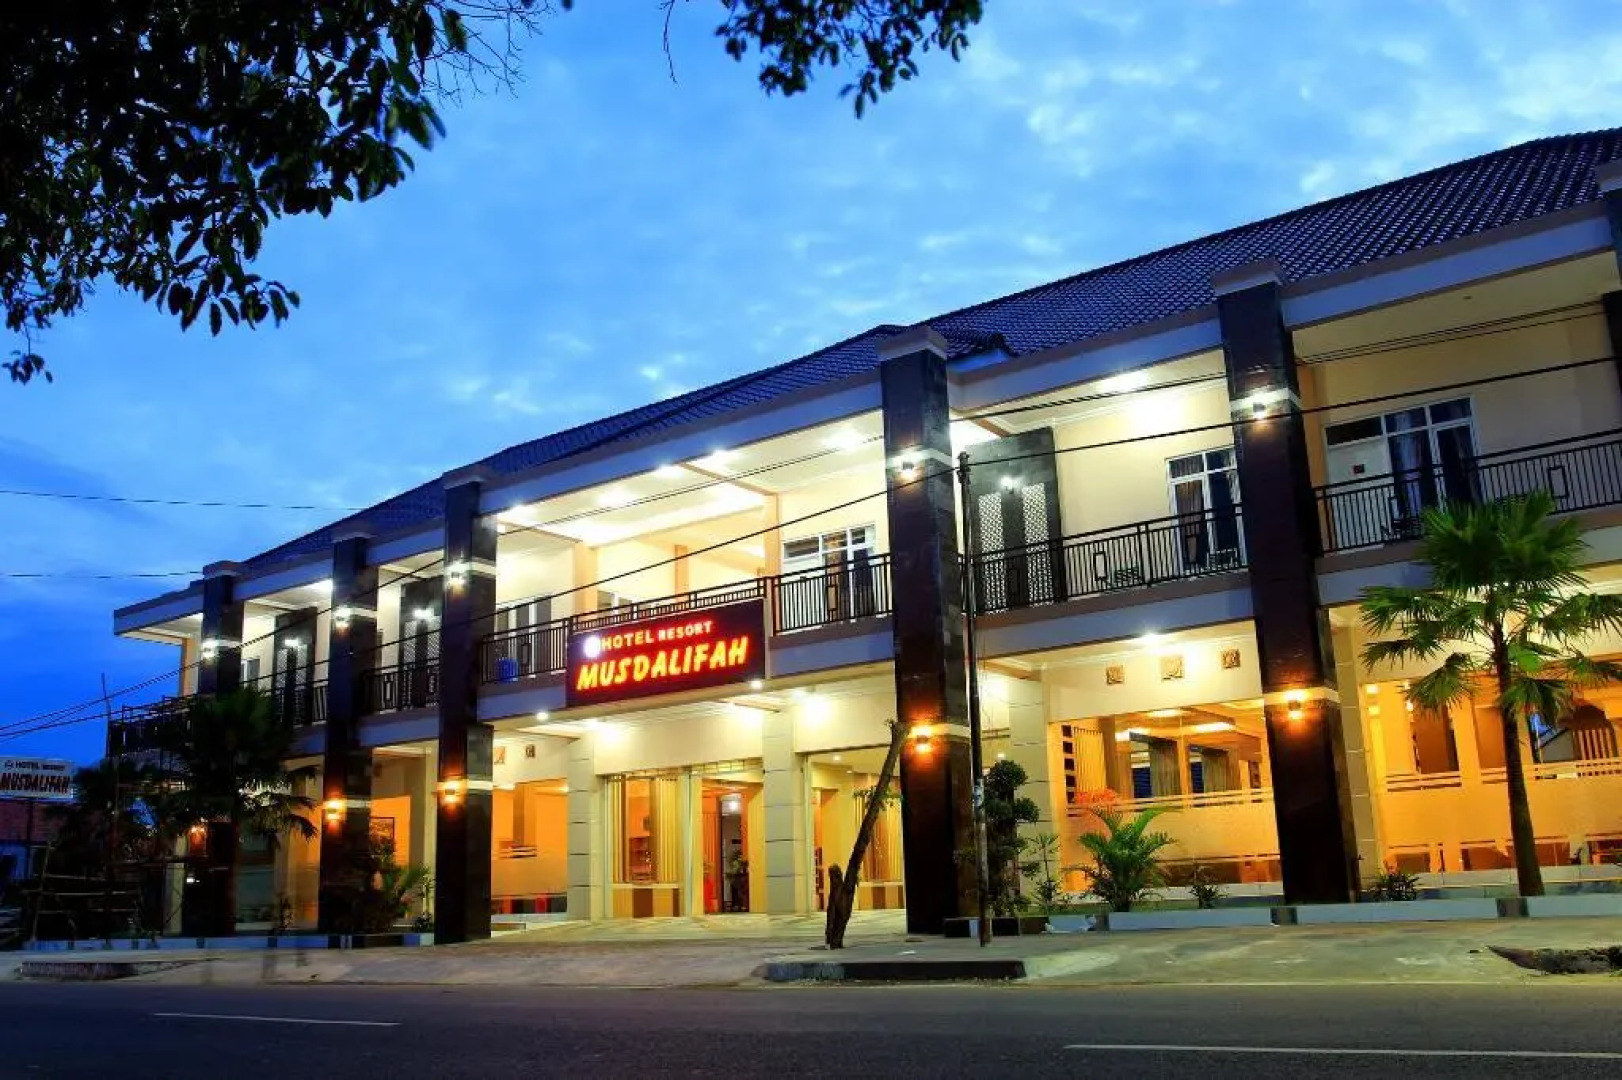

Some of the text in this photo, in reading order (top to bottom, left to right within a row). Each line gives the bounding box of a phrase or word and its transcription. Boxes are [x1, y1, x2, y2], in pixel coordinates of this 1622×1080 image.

[601, 620, 713, 651] HOTEL RESORT
[576, 636, 749, 690] MUSDALIFAH
[15, 761, 39, 770] HOTEL
